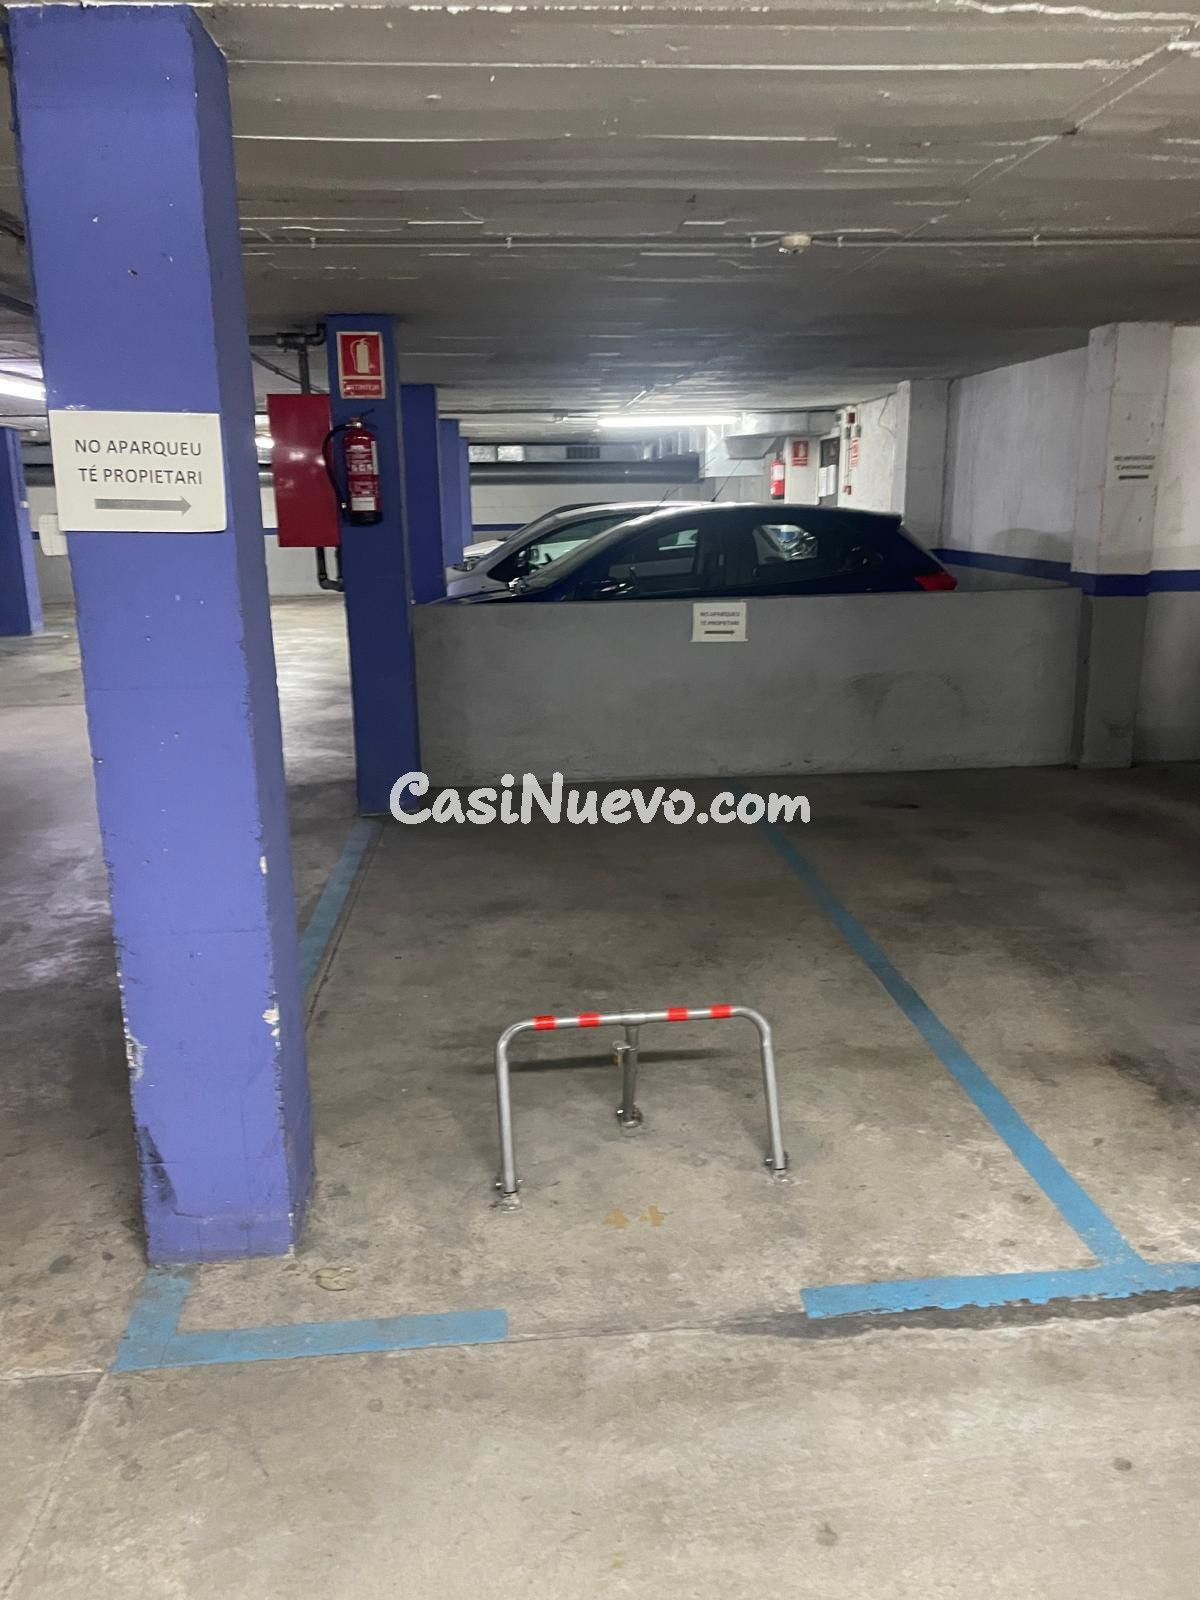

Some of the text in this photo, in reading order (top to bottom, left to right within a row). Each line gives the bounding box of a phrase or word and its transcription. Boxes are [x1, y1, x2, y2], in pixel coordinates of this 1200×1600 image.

[74, 439, 201, 457] NO APARQUEU
[78, 465, 202, 485] TÉ PROPIETARI
